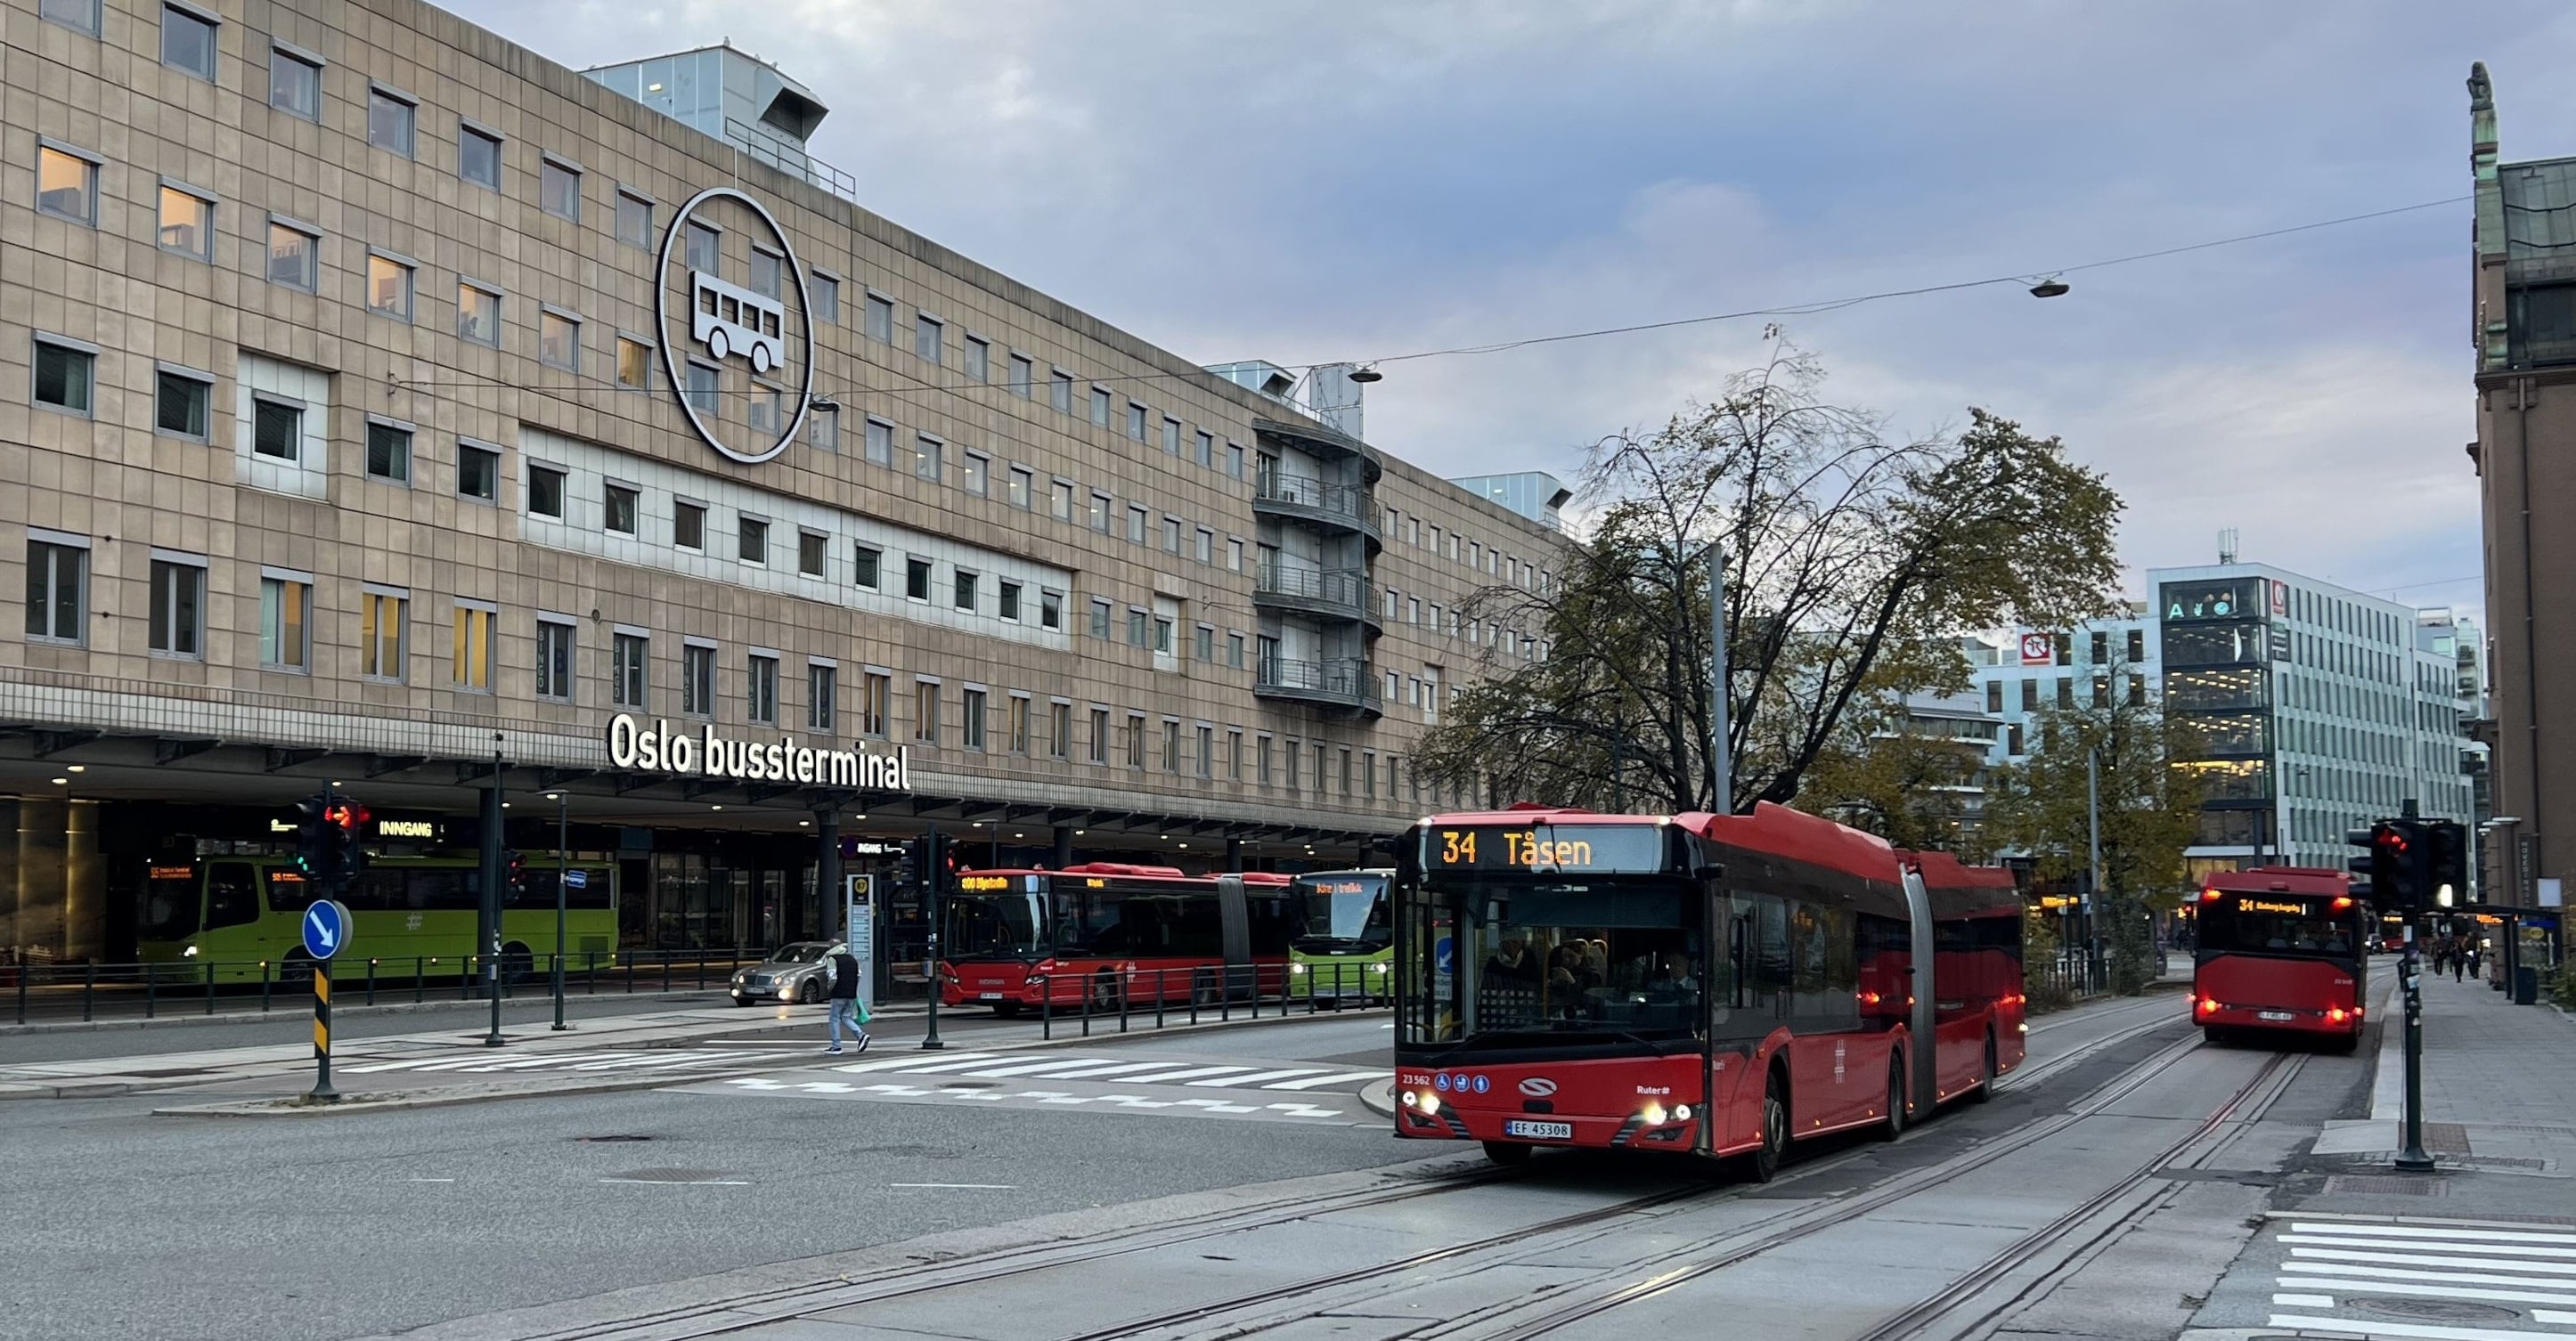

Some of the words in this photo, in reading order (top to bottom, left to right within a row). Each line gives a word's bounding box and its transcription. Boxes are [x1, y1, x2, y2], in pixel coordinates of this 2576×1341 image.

[537, 630, 545, 688] BINGO
[607, 713, 693, 773] Oslo
[702, 724, 910, 791] bussterminal
[379, 820, 433, 838] INNGANG
[1442, 832, 1476, 864] 34
[1504, 831, 1591, 866] Tåsen
[2239, 898, 2254, 911] 34
[1515, 1122, 1528, 1134] EF
[1532, 1123, 1569, 1137] 45308
